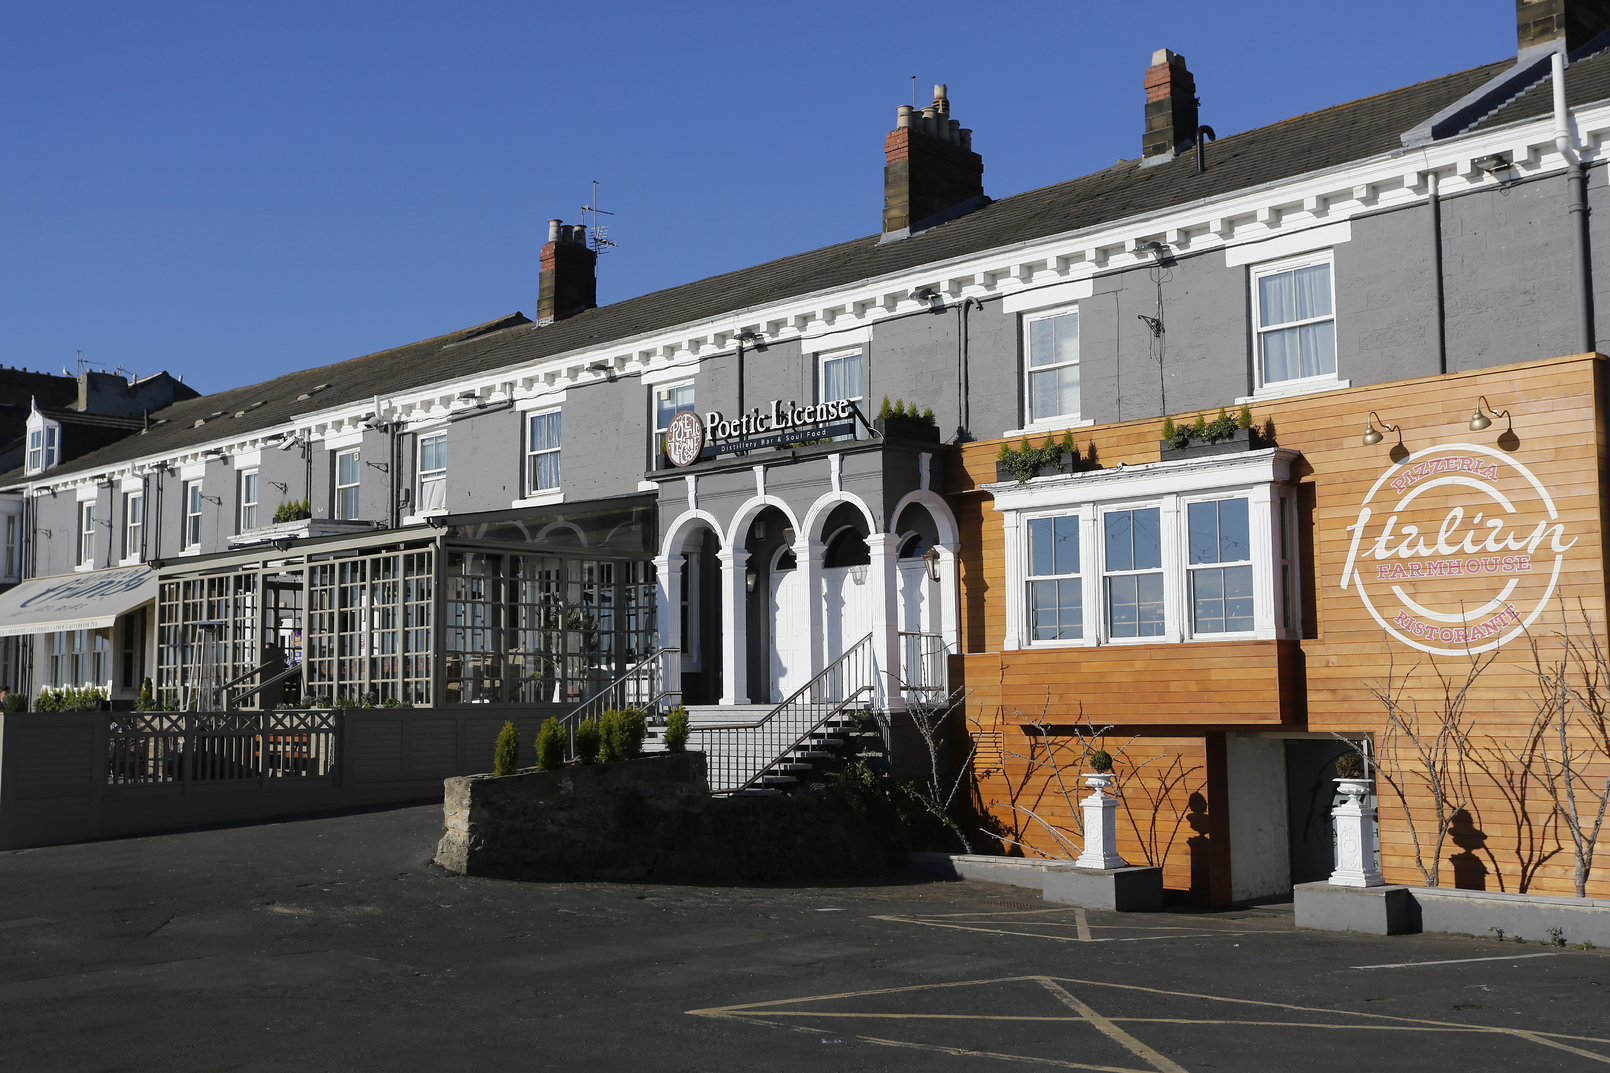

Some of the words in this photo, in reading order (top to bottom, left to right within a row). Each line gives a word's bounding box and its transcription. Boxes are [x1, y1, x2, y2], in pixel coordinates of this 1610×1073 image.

[668, 414, 701, 442] POETIC
[705, 407, 765, 440] Poetic
[770, 400, 849, 429] License
[721, 440, 757, 452] Distillery
[761, 437, 773, 446] Bar
[786, 432, 803, 441] Soul
[807, 429, 826, 438] Food
[1391, 456, 1500, 494] PIZZERIA
[1340, 506, 1579, 590] Italian
[1376, 555, 1533, 580] FARMHOUSE
[1393, 603, 1522, 644] RISTORANTE
